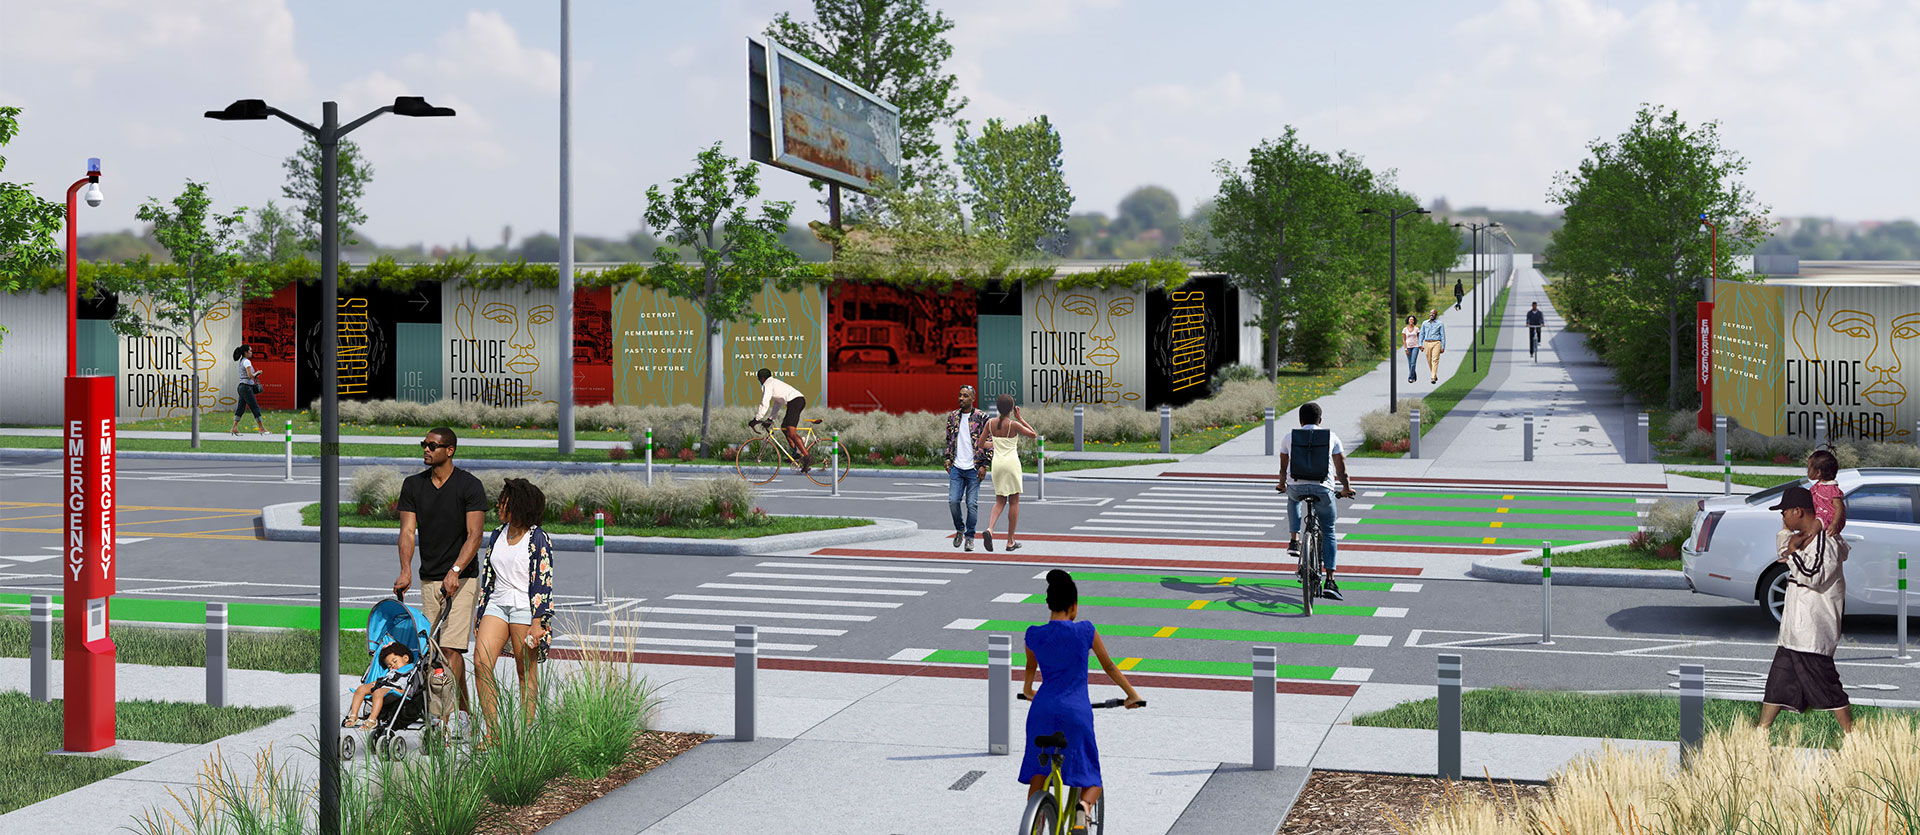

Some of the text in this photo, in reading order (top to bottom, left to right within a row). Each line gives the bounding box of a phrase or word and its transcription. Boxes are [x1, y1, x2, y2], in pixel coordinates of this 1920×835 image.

[1171, 291, 1206, 392] STRENGTH
[1713, 334, 1769, 350] EMEMBERS THE
[1722, 321, 1752, 331] DETROIT
[127, 335, 183, 370] FUTURE
[336, 297, 368, 395] STRENGTH
[450, 339, 506, 374] FUTURE
[1031, 331, 1087, 366] FUTURE
[1701, 319, 1709, 385] EMERGENCY
[1737, 354, 1767, 366] CREATE
[403, 371, 423, 388] JOE
[983, 363, 1003, 380] JOE
[983, 380, 1017, 397] LOUIS
[1031, 369, 1104, 404] FORWARD
[1713, 364, 1760, 380] THE FUTURE
[1786, 359, 1861, 406] FUTURE
[127, 373, 200, 408] FORWARD
[451, 377, 523, 408] FORWARD
[69, 420, 84, 582] EMERGENCY
[100, 419, 112, 580] EMERGENCY
